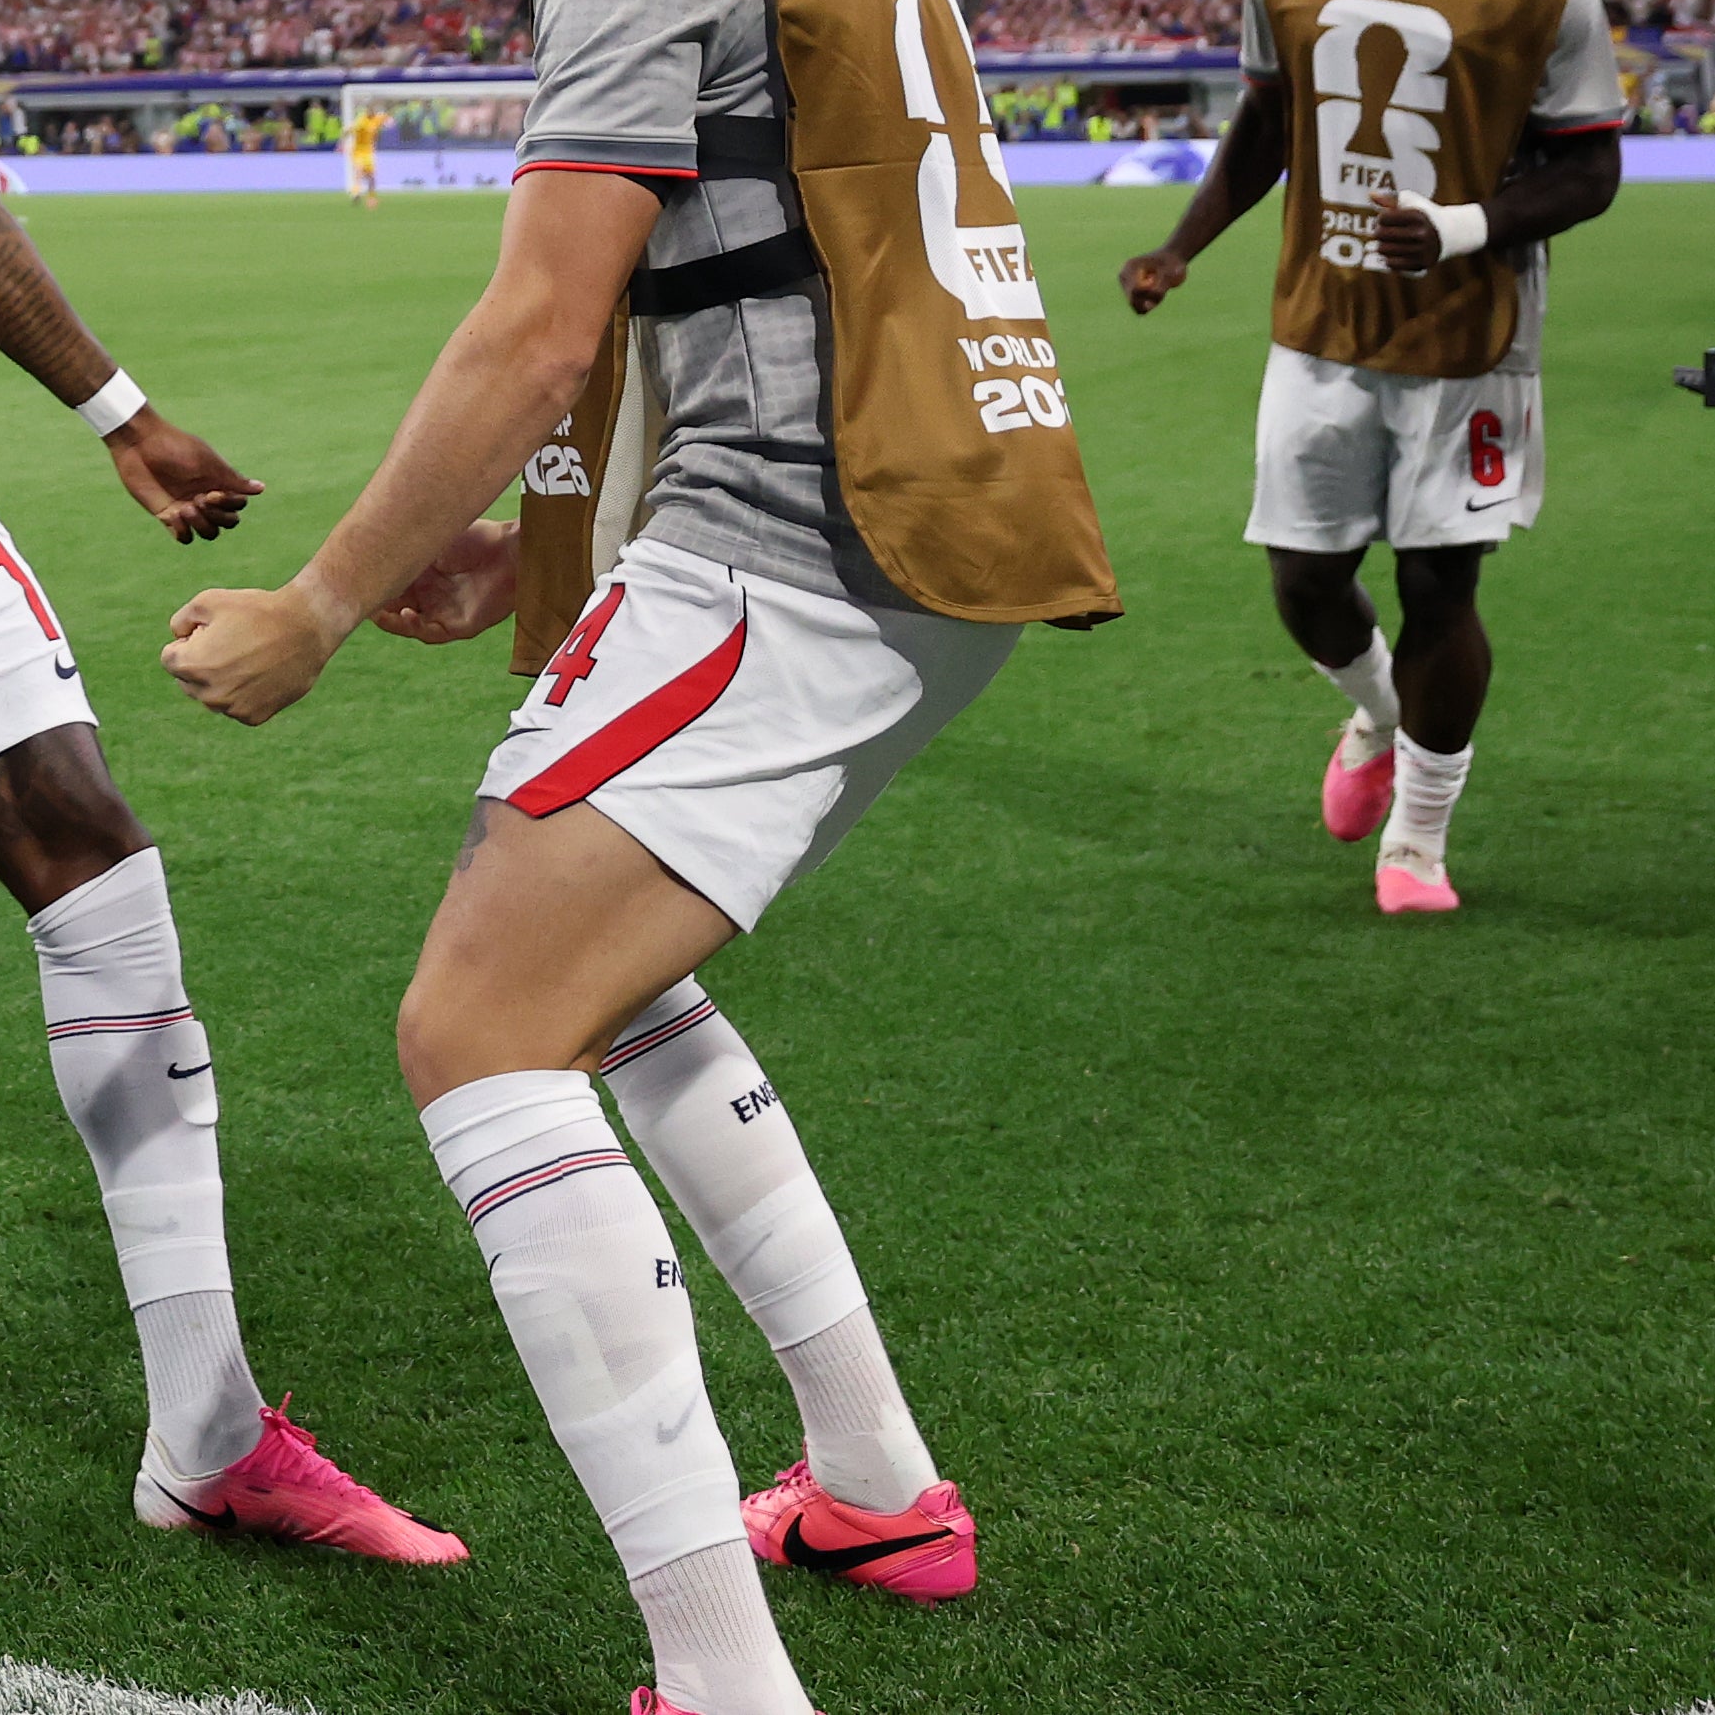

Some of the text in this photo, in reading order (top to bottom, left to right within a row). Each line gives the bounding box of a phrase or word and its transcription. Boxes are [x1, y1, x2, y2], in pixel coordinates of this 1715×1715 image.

[1340, 164, 1396, 190] FIFA
[957, 334, 1056, 372] WORLD
[521, 444, 590, 497] 026
[1469, 409, 1506, 487] 6
[544, 582, 625, 707] 4
